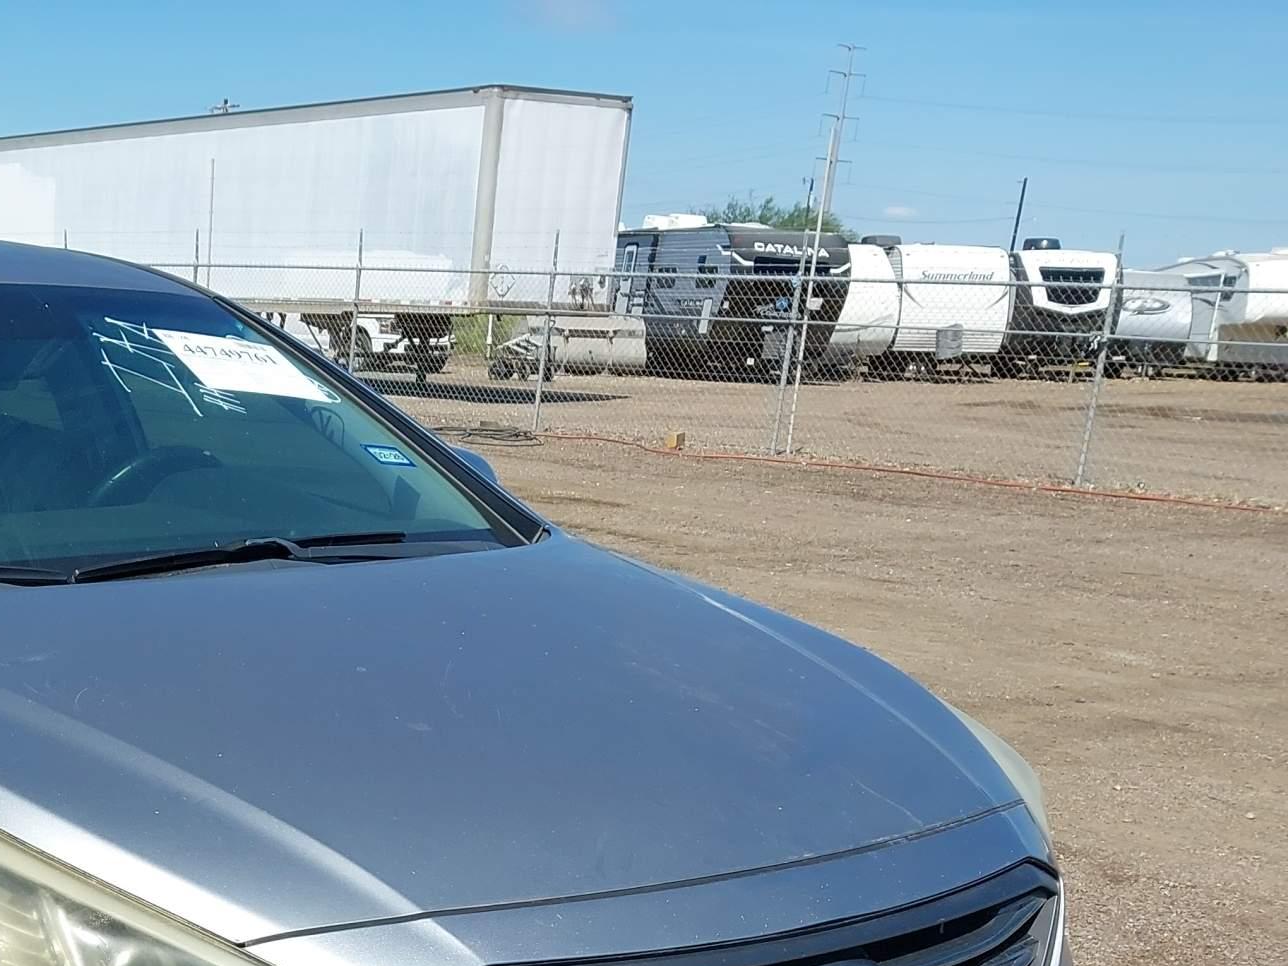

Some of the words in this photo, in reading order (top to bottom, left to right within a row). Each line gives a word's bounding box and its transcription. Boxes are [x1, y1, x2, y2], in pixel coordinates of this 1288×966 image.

[754, 242, 830, 258] CATALNA
[921, 270, 995, 281] Summerland
[183, 343, 277, 364] 44749761
